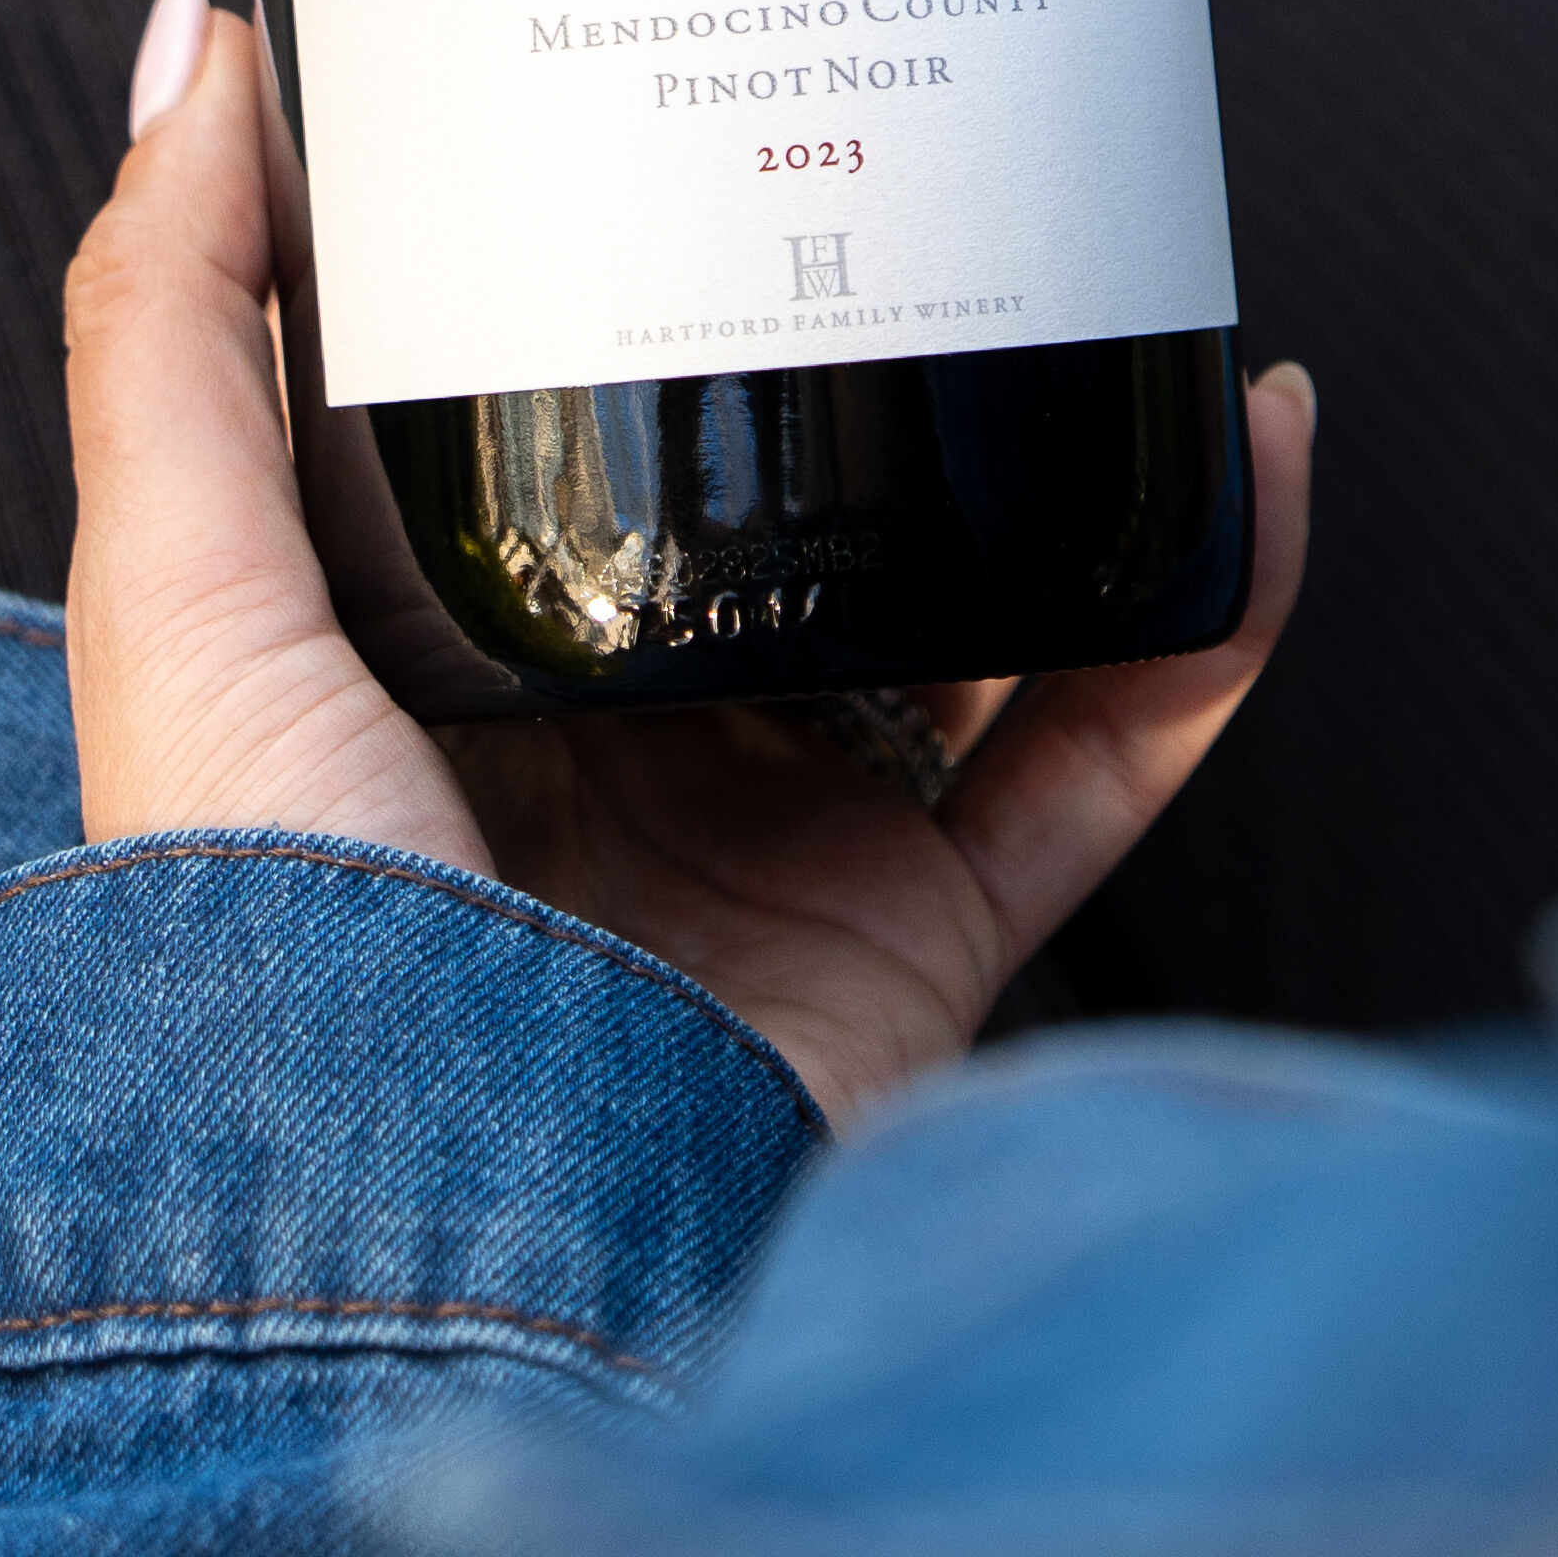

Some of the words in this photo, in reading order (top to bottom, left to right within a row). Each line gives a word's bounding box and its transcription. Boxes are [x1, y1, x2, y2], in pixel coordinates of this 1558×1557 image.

[758, 140, 863, 174] 2023
[617, 318, 780, 346] HARTFORD
[793, 306, 903, 331] FAMILY
[914, 296, 1023, 319] WINERY
